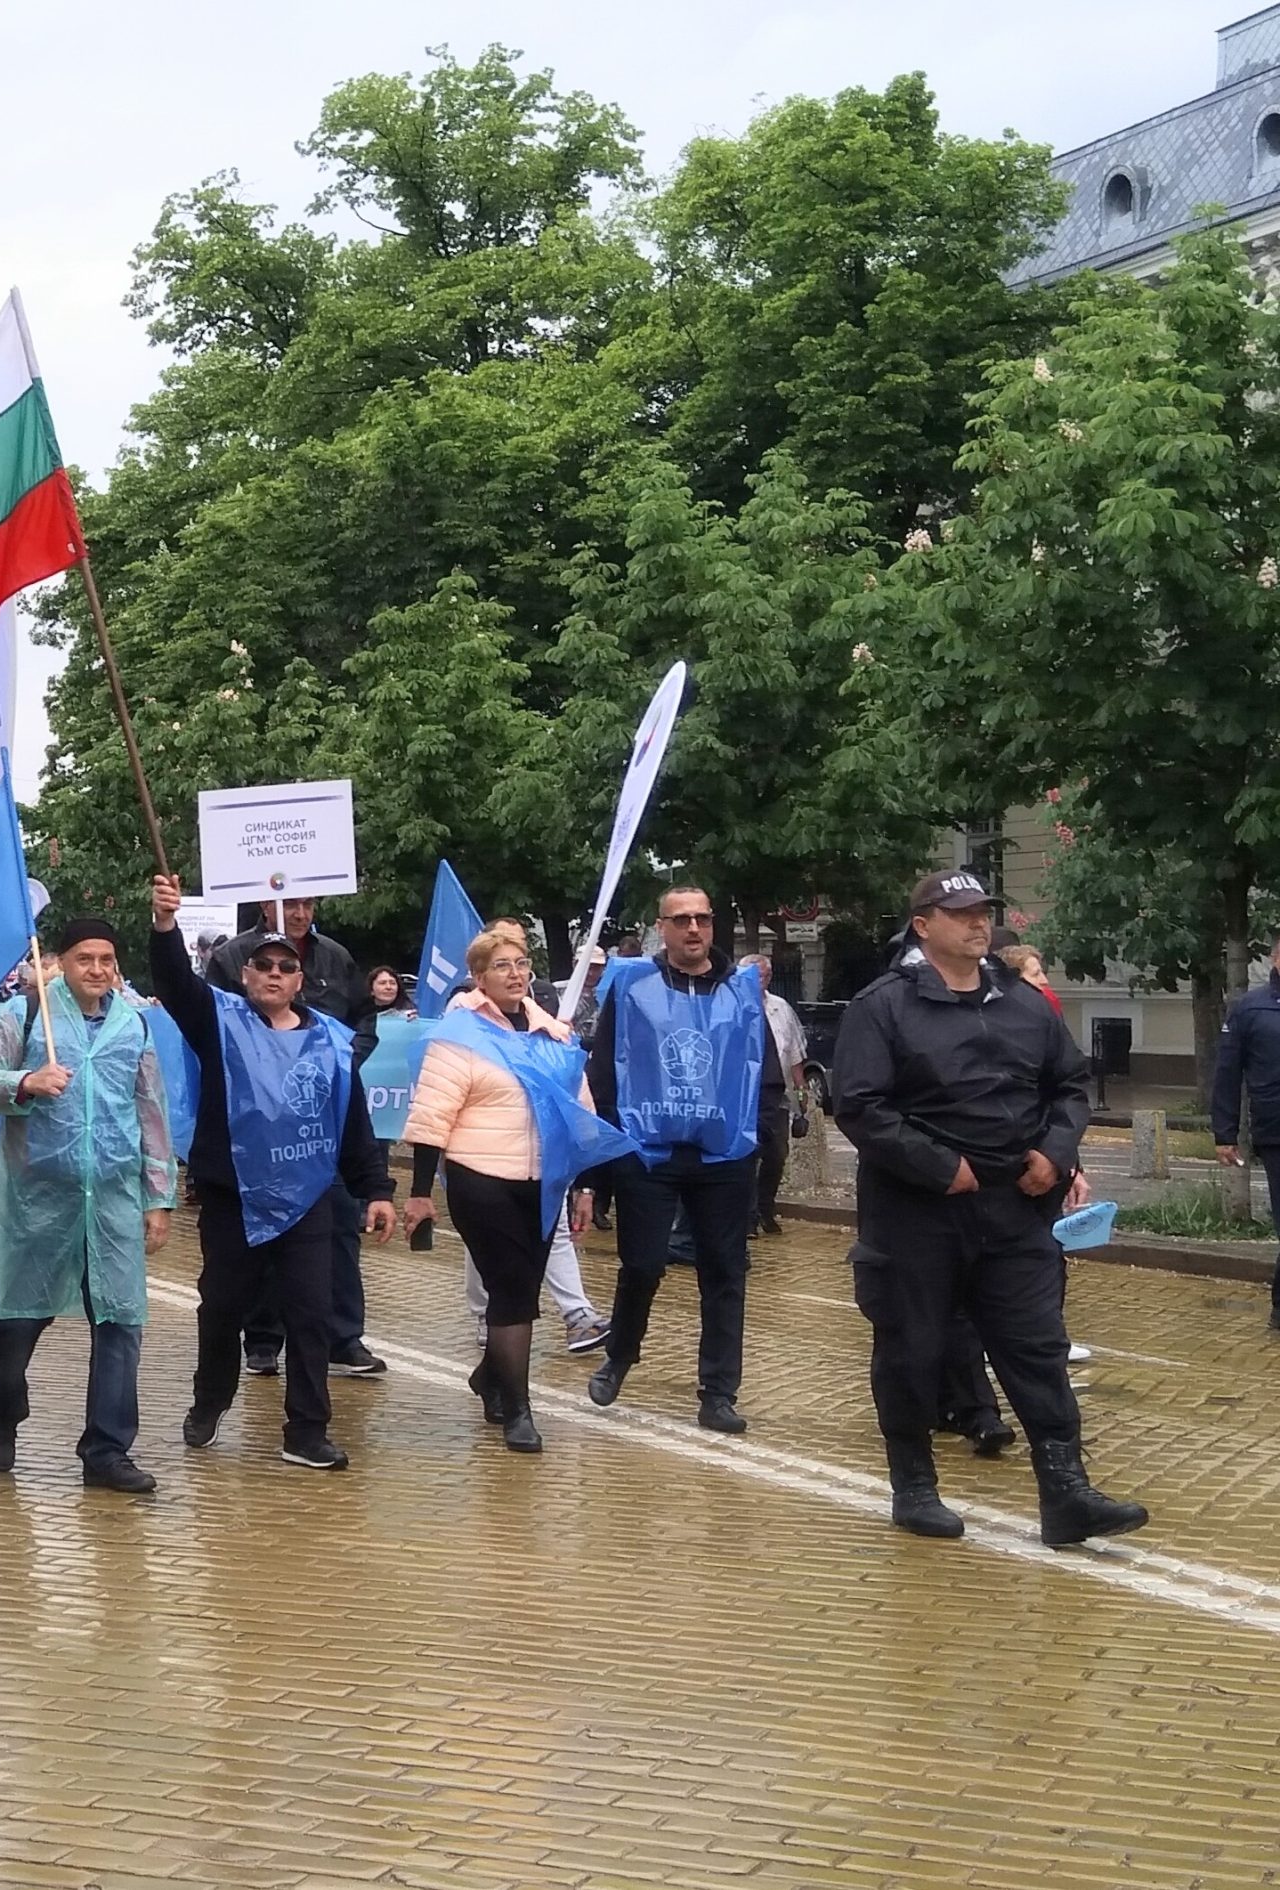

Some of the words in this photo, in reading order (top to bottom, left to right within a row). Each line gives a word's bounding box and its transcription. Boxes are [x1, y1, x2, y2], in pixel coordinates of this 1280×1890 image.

[244, 818, 307, 834] СИНДИКАТ
[274, 830, 317, 842] СОФИЯ
[247, 847, 274, 858] КЪМ
[276, 843, 307, 855] СТСБ
[666, 1085, 703, 1100] ФТР
[641, 1101, 727, 1121] ПОДКРЕПА
